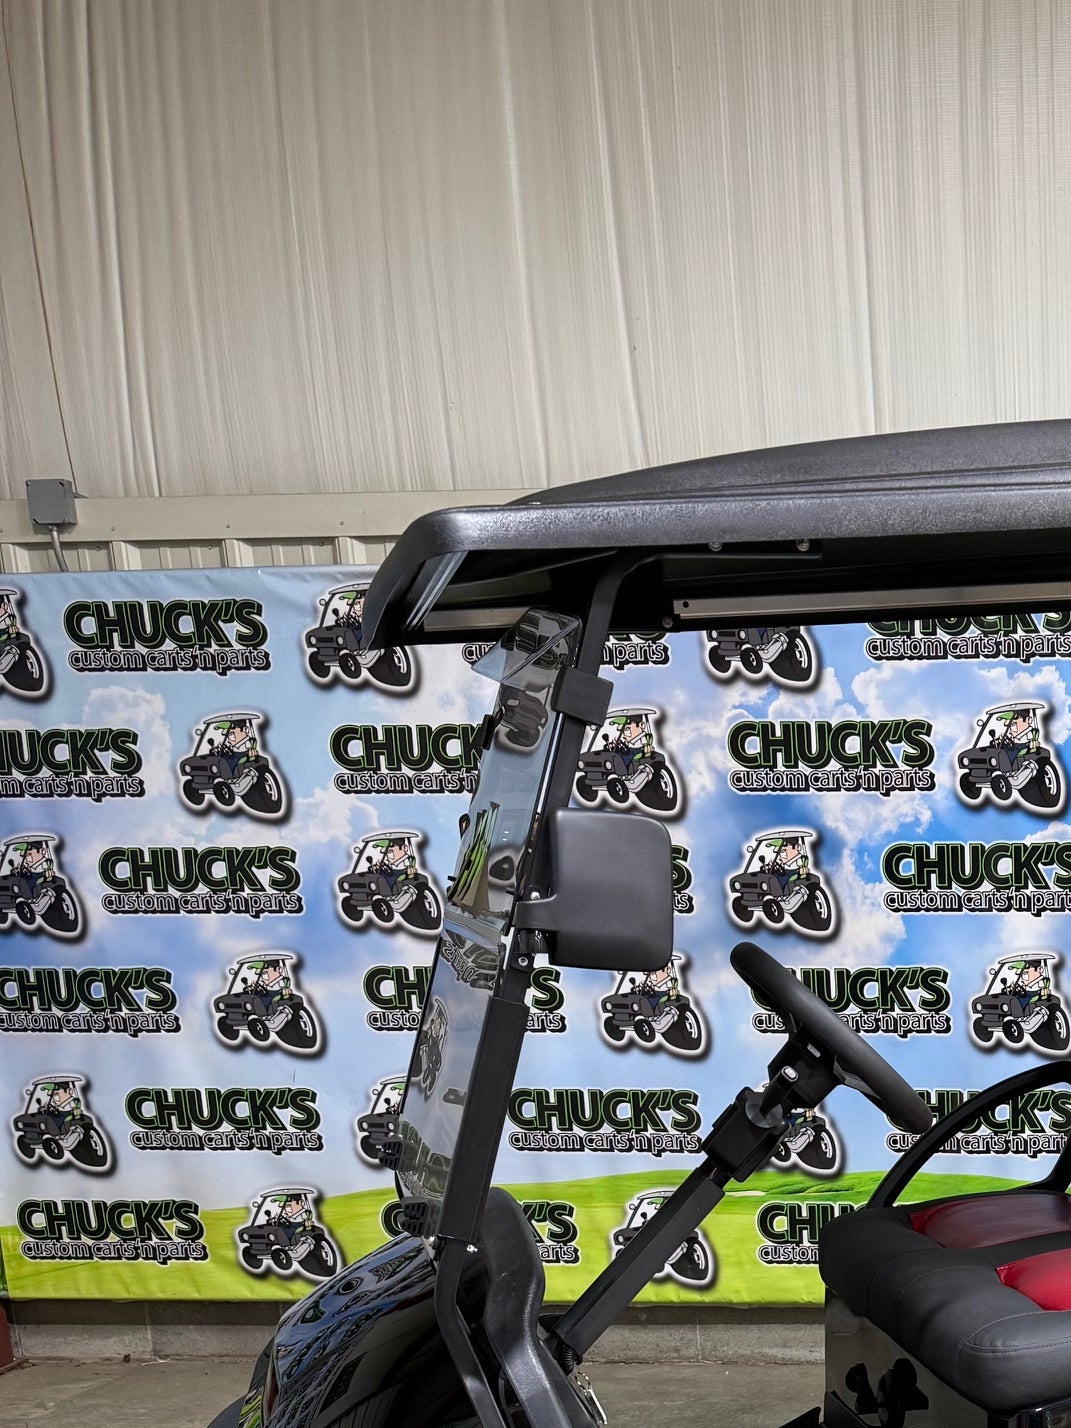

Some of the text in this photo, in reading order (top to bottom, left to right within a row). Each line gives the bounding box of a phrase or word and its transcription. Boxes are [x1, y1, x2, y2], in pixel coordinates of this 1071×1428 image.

[64, 598, 268, 648] CHUCK'S
[611, 641, 668, 669] parts
[866, 636, 945, 657] custom
[69, 649, 145, 670] custom
[216, 649, 270, 675] parts
[0, 728, 143, 776] UCK'S
[329, 724, 482, 771] CHUCK
[728, 719, 935, 769] CHUCK'S
[91, 775, 141, 801] parts
[335, 772, 410, 791] custom
[730, 769, 806, 790] custom
[879, 768, 932, 794] parts
[98, 846, 301, 893] CHUCK'S
[102, 893, 176, 912] custom
[249, 892, 300, 917] parts
[884, 890, 960, 910] custom
[751, 967, 950, 1013] UCK'S
[127, 1012, 178, 1036] parts
[367, 1010, 421, 1030] custo
[526, 1011, 563, 1030] arts
[897, 1012, 948, 1036] parts
[125, 1087, 321, 1131] CHUCK'S
[507, 1088, 702, 1133] CHUCK'S
[130, 1130, 200, 1148] custom
[269, 1130, 321, 1153] parts
[509, 1131, 581, 1150] custom
[651, 1132, 701, 1155] parts
[1028, 1133, 1068, 1156] part
[17, 1199, 205, 1240] CHUCK'S
[22, 1240, 90, 1258] custom
[157, 1240, 205, 1262] parts
[538, 1243, 578, 1262] arts
